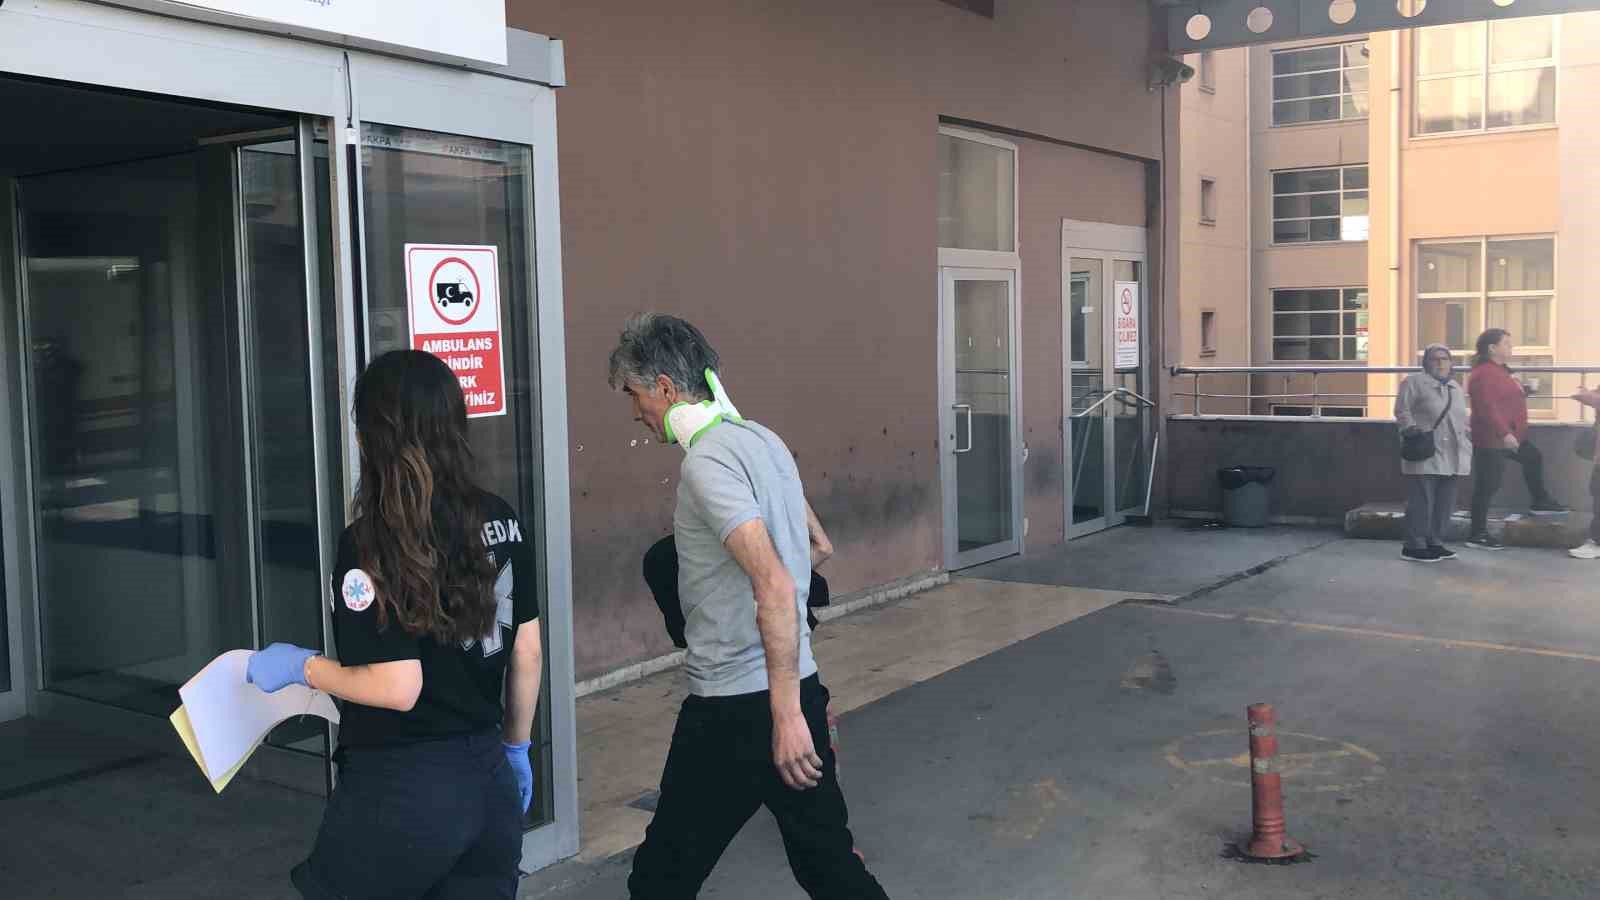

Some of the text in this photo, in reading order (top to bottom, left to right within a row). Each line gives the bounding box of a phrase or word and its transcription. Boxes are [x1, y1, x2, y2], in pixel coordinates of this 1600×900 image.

[422, 337, 493, 353] AMBULANS
[441, 354, 484, 370] İNDİR
[459, 375, 478, 389] RK
